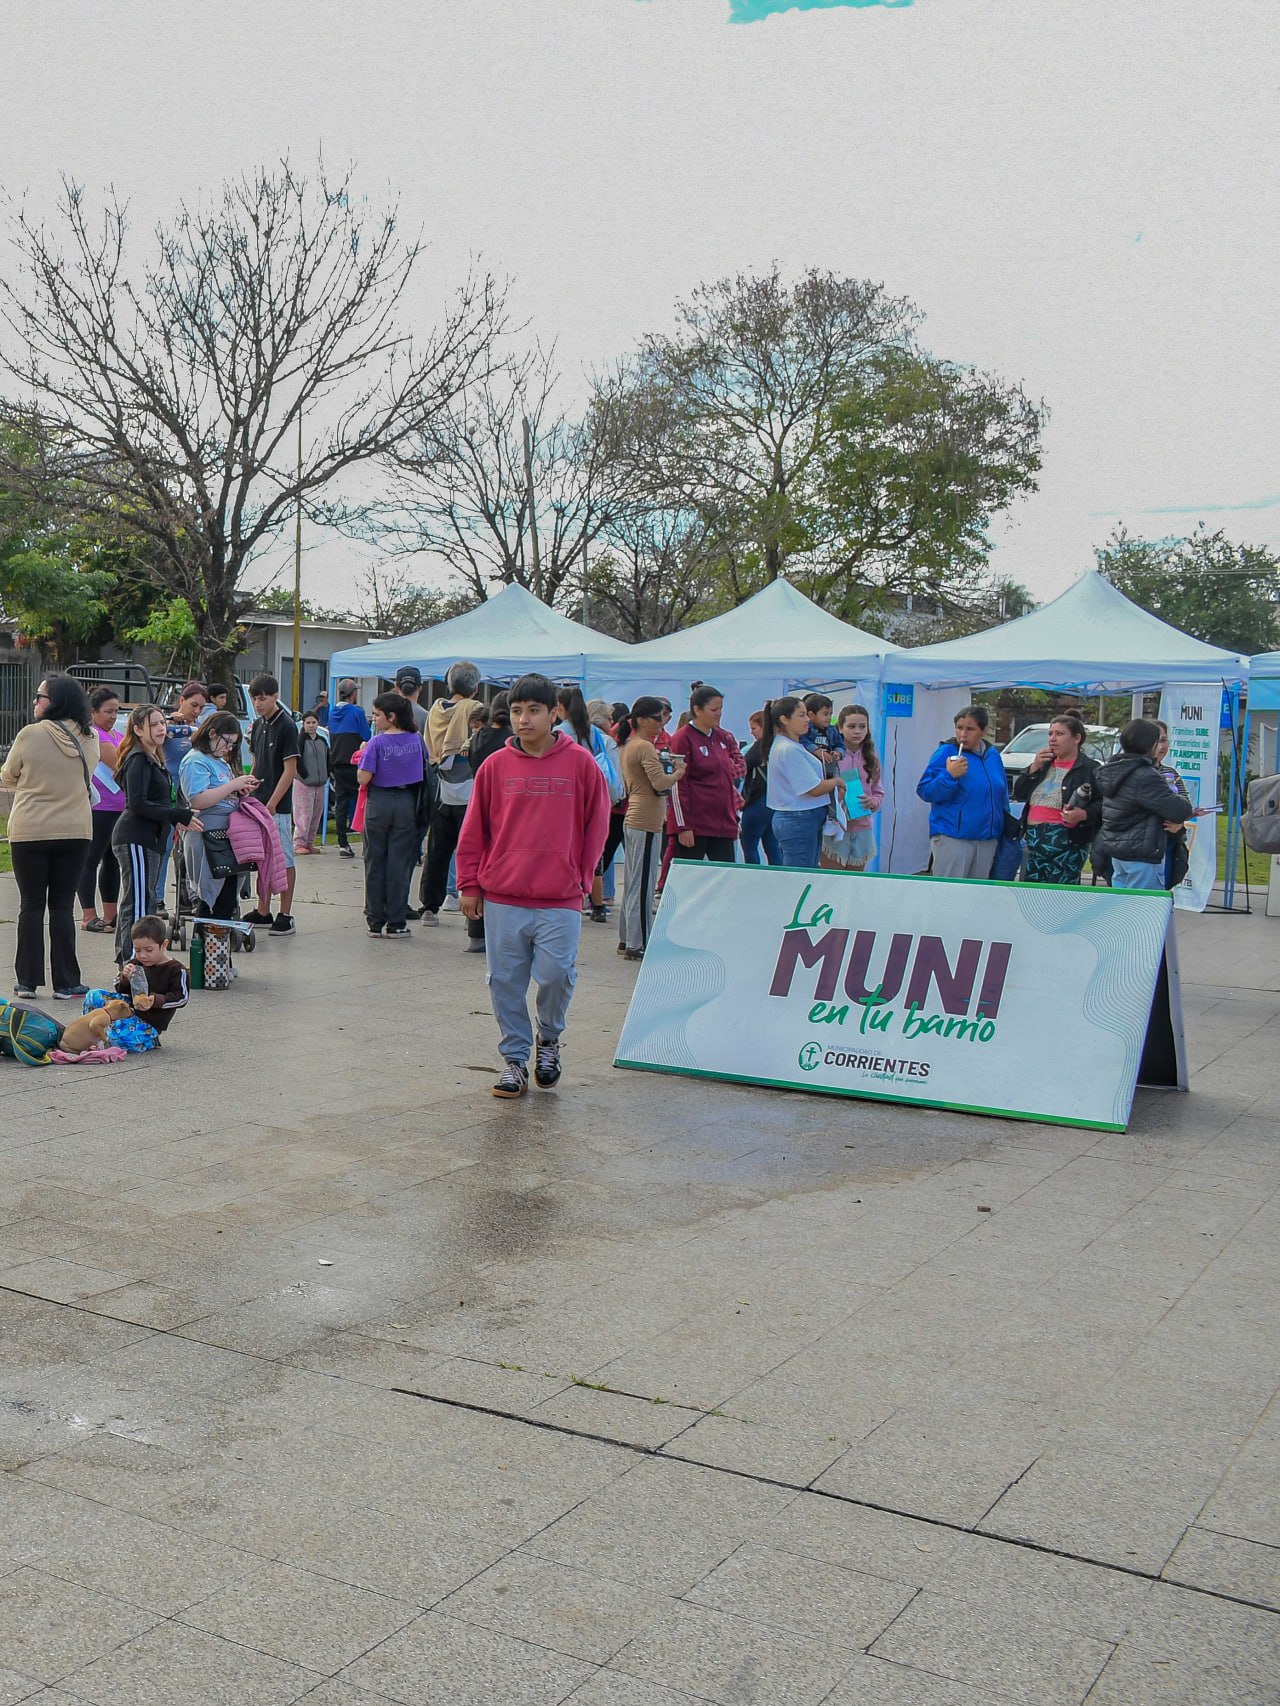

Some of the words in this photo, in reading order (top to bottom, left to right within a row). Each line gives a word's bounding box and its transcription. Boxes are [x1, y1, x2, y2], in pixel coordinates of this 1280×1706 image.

[887, 692, 912, 705] SUBE
[1180, 704, 1203, 721] MUNI
[1169, 748, 1208, 760] TRANSPORTE
[784, 884, 834, 930] La
[768, 928, 1013, 1020] MUNI
[807, 1001, 850, 1026] en
[859, 983, 894, 1035] tu
[902, 1000, 996, 1043] barrio
[823, 1051, 931, 1077] CORRIENTES
